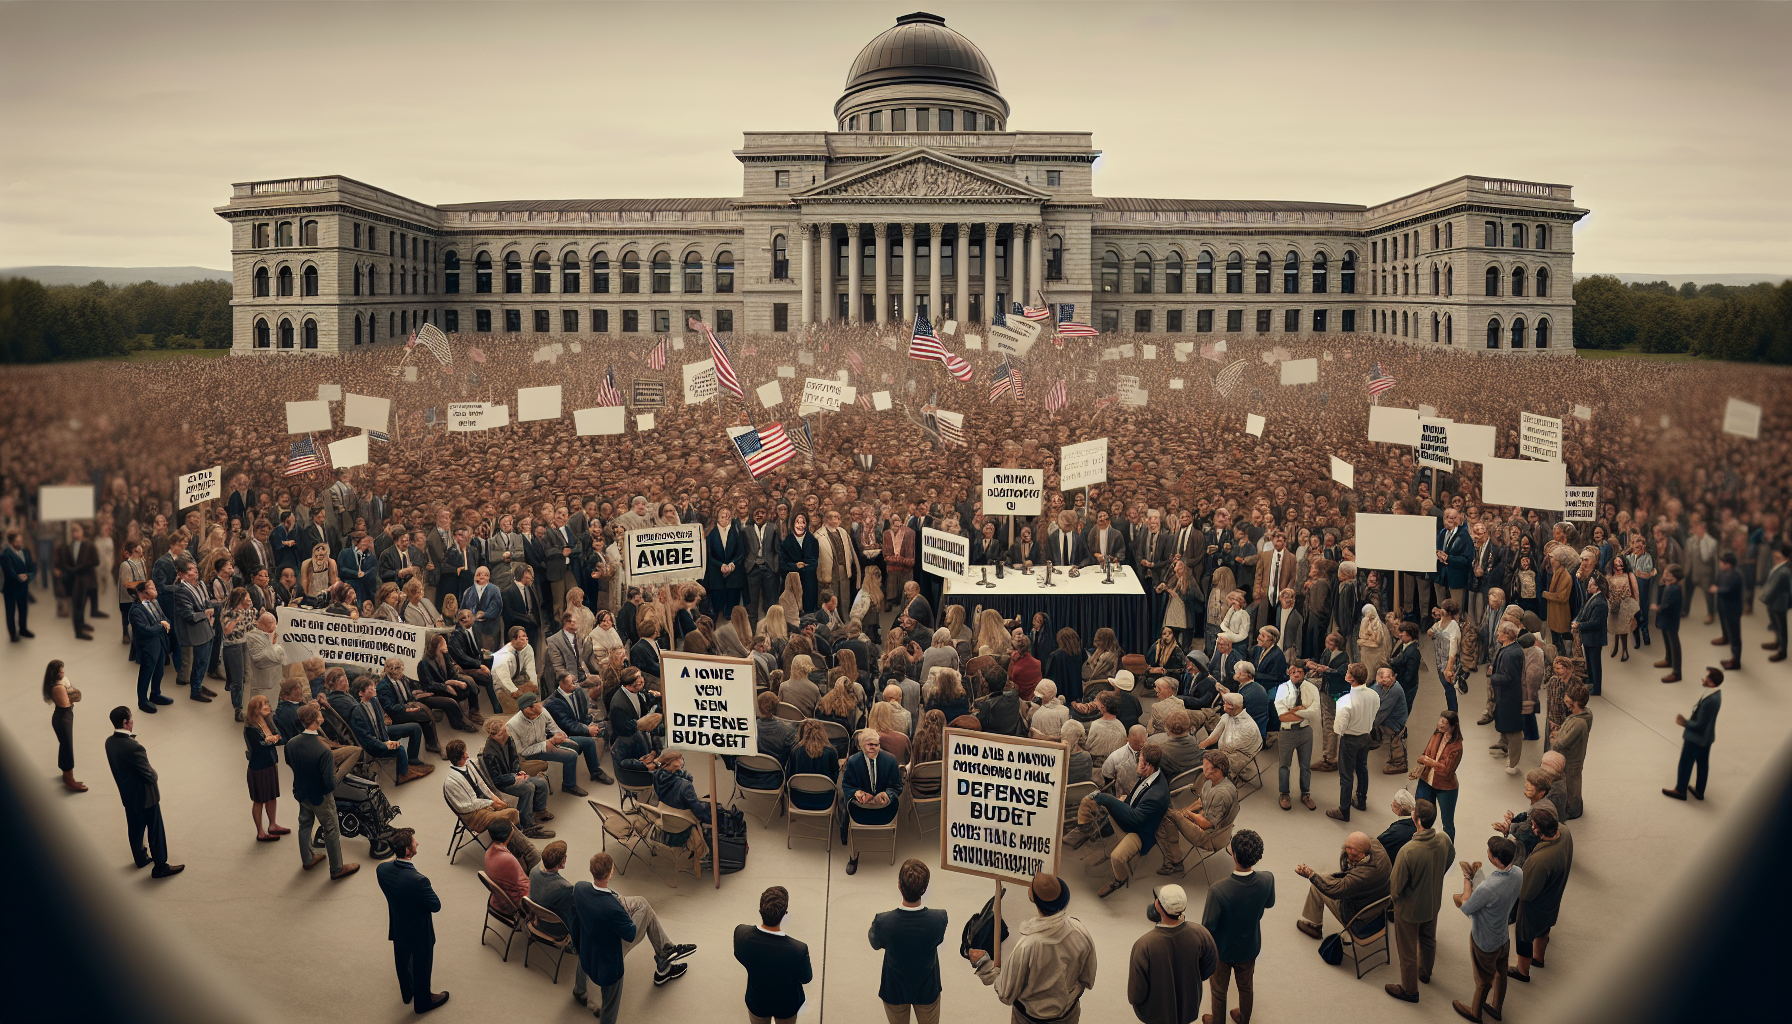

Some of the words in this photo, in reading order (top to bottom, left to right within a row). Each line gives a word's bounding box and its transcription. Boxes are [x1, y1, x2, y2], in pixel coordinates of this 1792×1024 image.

[672, 729, 751, 749] BUDGET
[957, 778, 1049, 809] DEFENSE
[970, 801, 1037, 827] BUDET
